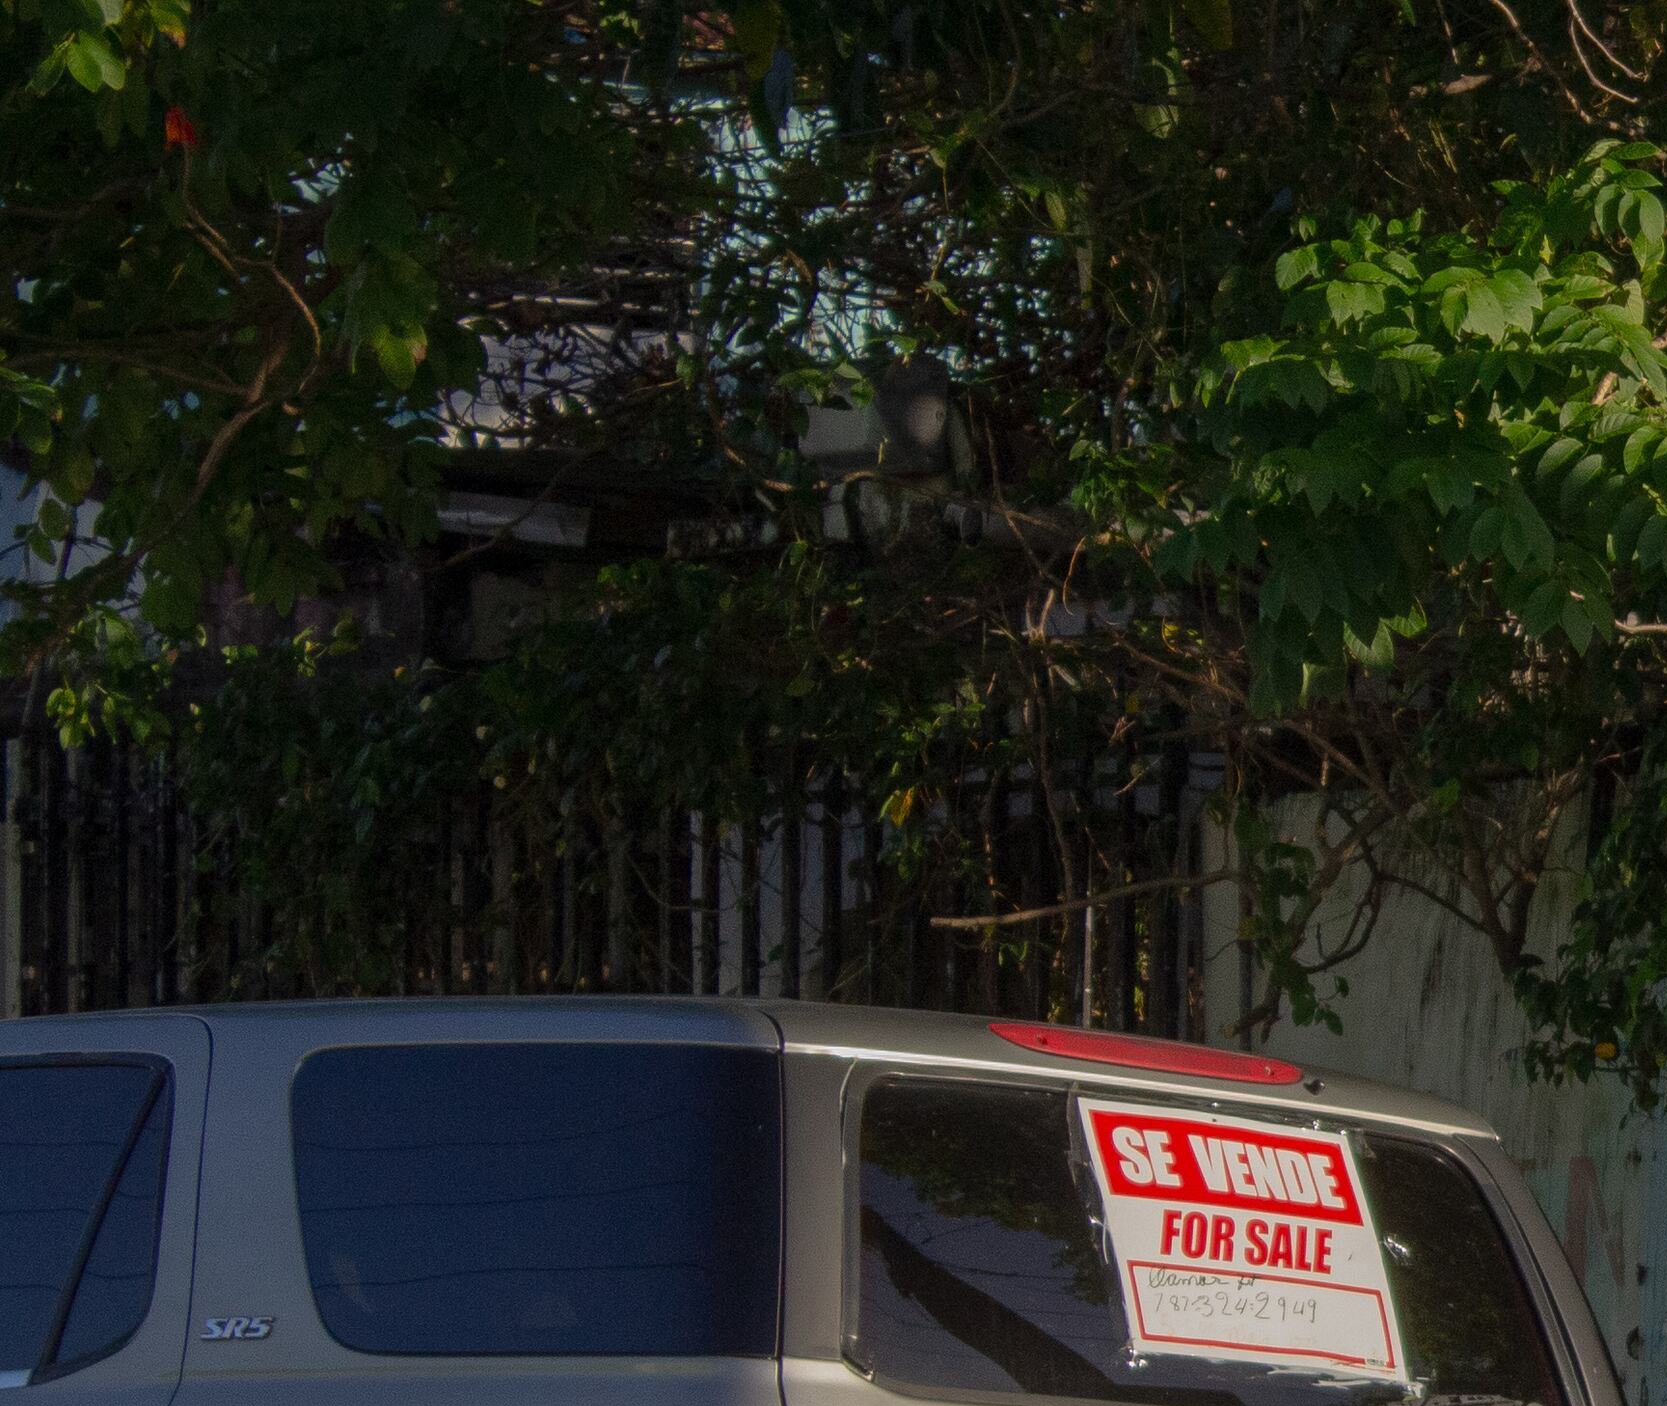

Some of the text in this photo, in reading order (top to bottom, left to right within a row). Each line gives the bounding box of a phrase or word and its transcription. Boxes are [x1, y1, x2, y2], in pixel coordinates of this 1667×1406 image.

[1111, 1126, 1347, 1209] SE VENDE
[1160, 1208, 1333, 1275] FOR SALE
[201, 1316, 273, 1340] SR5
